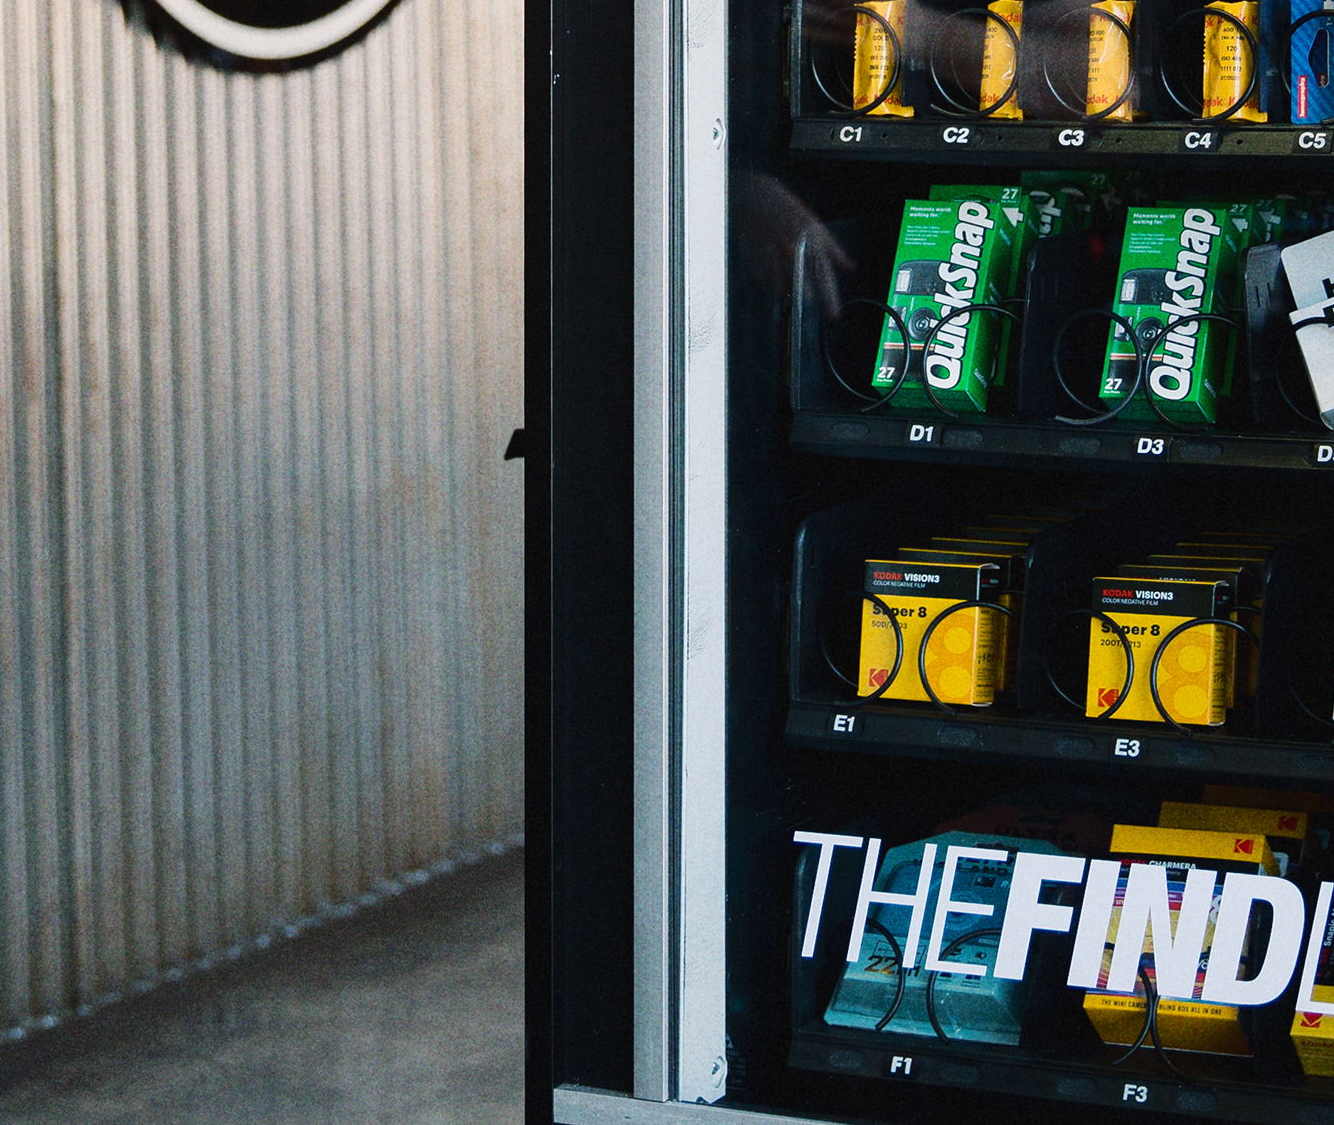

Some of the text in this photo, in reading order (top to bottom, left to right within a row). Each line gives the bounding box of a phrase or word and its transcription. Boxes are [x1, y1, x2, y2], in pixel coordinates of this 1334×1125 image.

[839, 126, 863, 142] C1
[943, 127, 970, 143] C2
[1058, 130, 1085, 146] C3
[1184, 132, 1211, 149] C4
[1298, 132, 1326, 148] C5
[1001, 188, 1019, 200] 27
[925, 201, 995, 390] QuickSnap
[1149, 207, 1222, 401] QuickSnap
[877, 367, 896, 380] 27
[1104, 379, 1122, 391] 27
[910, 425, 934, 443] D1
[1138, 439, 1165, 455] D3
[873, 572, 940, 583] KODAK VISION3
[1102, 589, 1174, 600] KODAK VISION3
[872, 603, 927, 618] Sper 8
[1101, 622, 1160, 636] Sper 8
[833, 714, 856, 732] E1
[1115, 738, 1140, 757] E3
[891, 1055, 913, 1075] F1
[1123, 1083, 1148, 1103] F3
